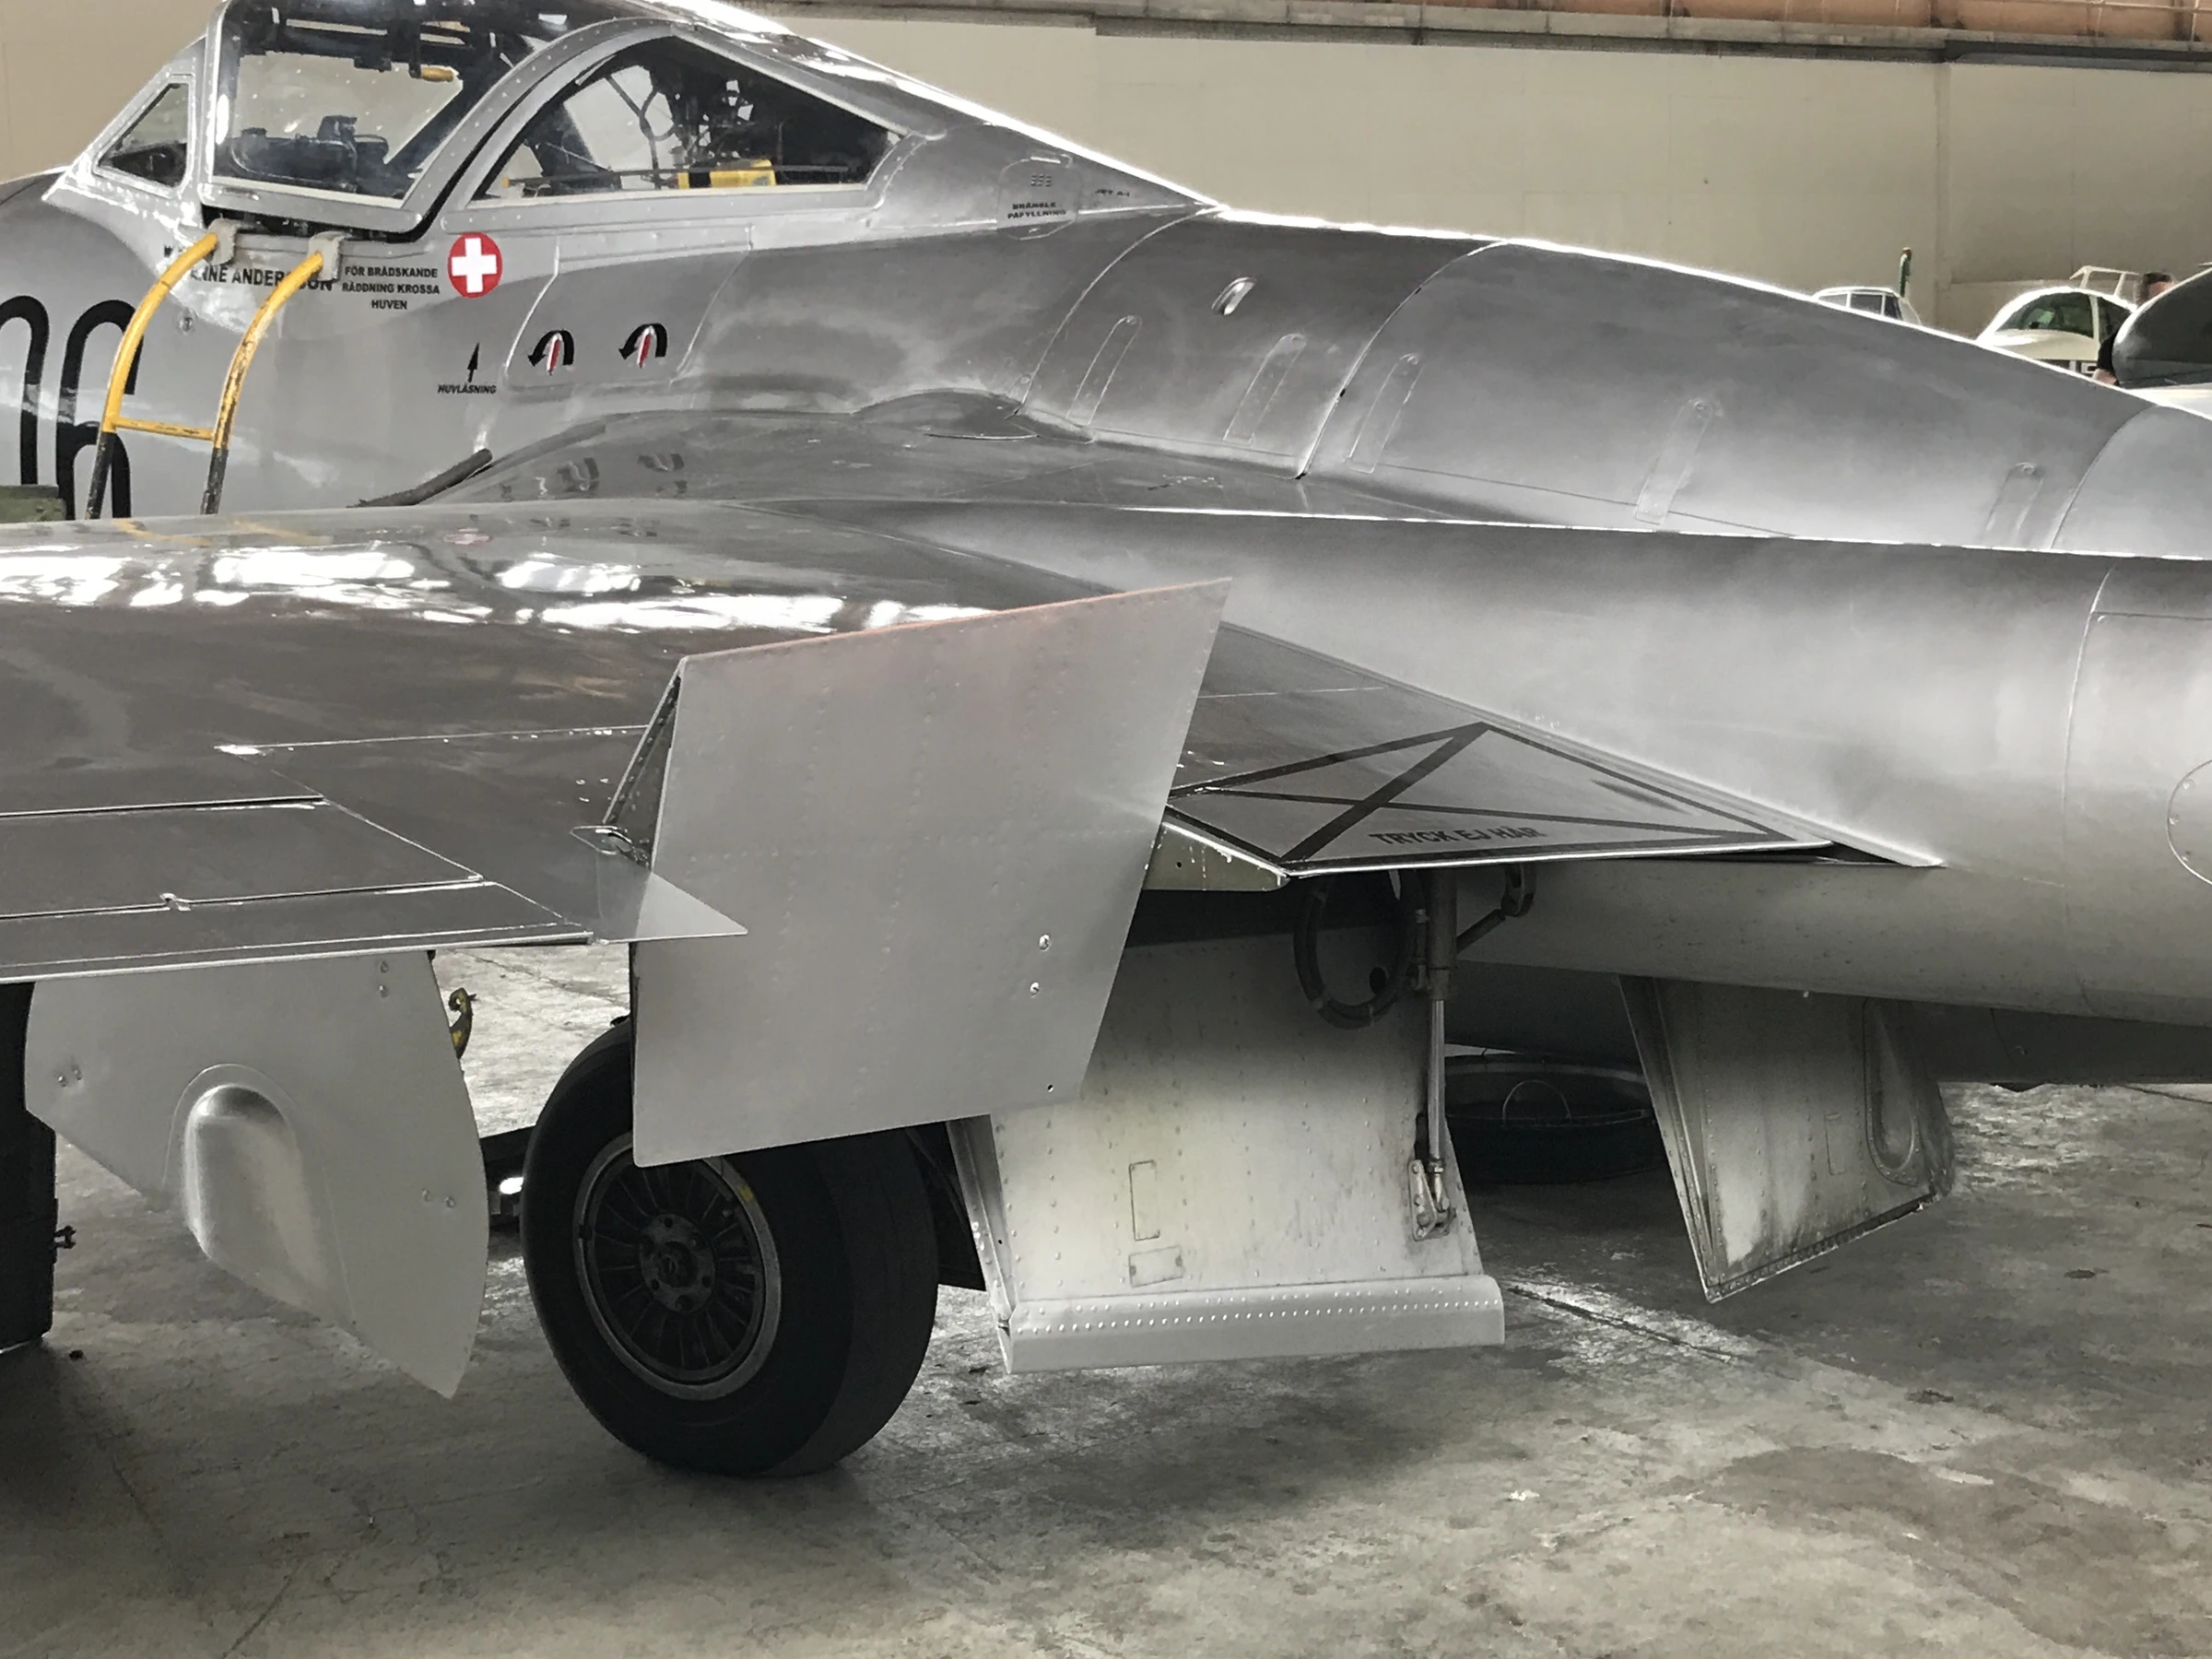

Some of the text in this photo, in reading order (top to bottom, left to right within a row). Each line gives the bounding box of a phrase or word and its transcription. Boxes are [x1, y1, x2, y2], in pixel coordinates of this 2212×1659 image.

[345, 265, 365, 276] FÖR
[397, 283, 440, 295] KROSSA
[371, 300, 407, 310] HUVEN
[1369, 830, 1459, 844] TRYCK
[1453, 830, 1492, 841] EJ
